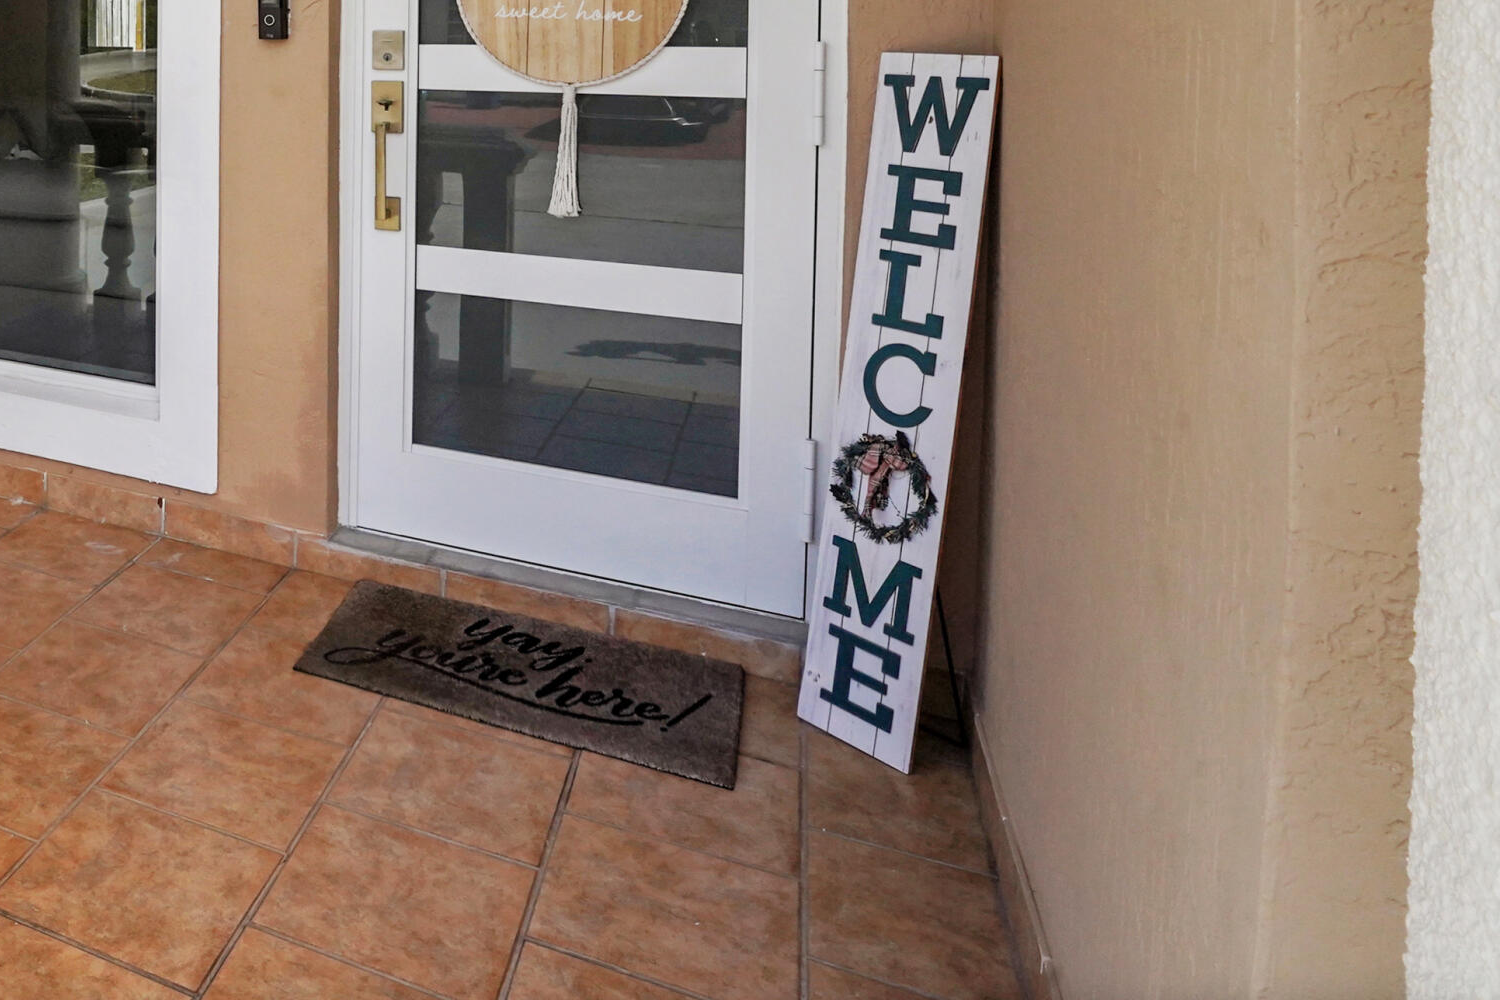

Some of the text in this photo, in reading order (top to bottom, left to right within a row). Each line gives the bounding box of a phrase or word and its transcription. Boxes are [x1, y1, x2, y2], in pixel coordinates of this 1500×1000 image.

[494, 0, 644, 23] sweet home
[535, 665, 713, 733] here!
